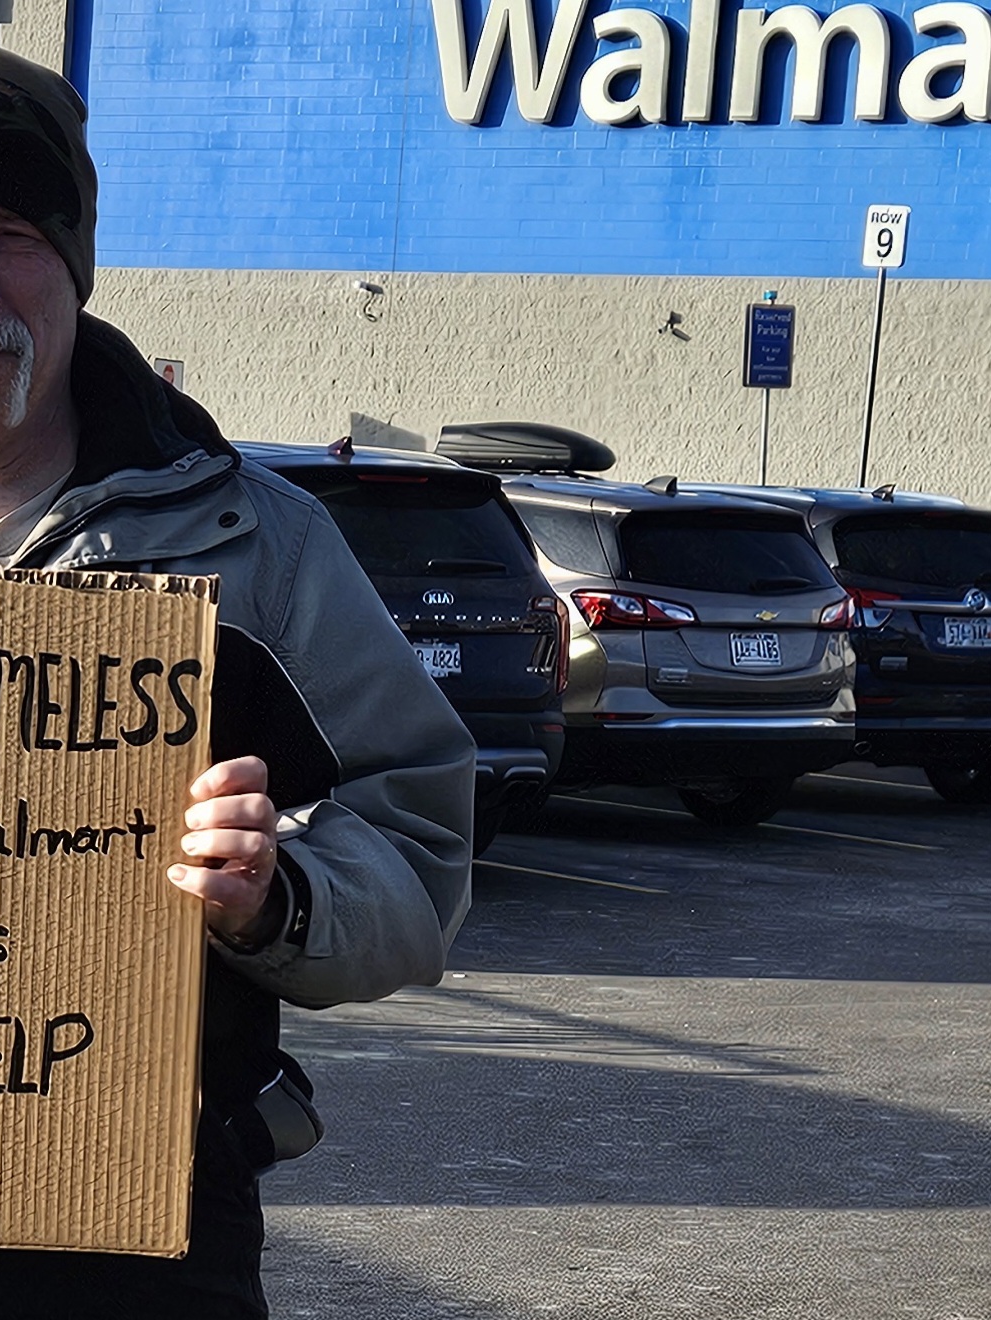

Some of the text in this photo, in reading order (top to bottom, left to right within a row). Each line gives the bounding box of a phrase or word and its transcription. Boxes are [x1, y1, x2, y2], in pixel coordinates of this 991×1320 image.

[877, 228, 893, 258] 9
[756, 323, 789, 339] Parking
[428, 593, 450, 605] KIA
